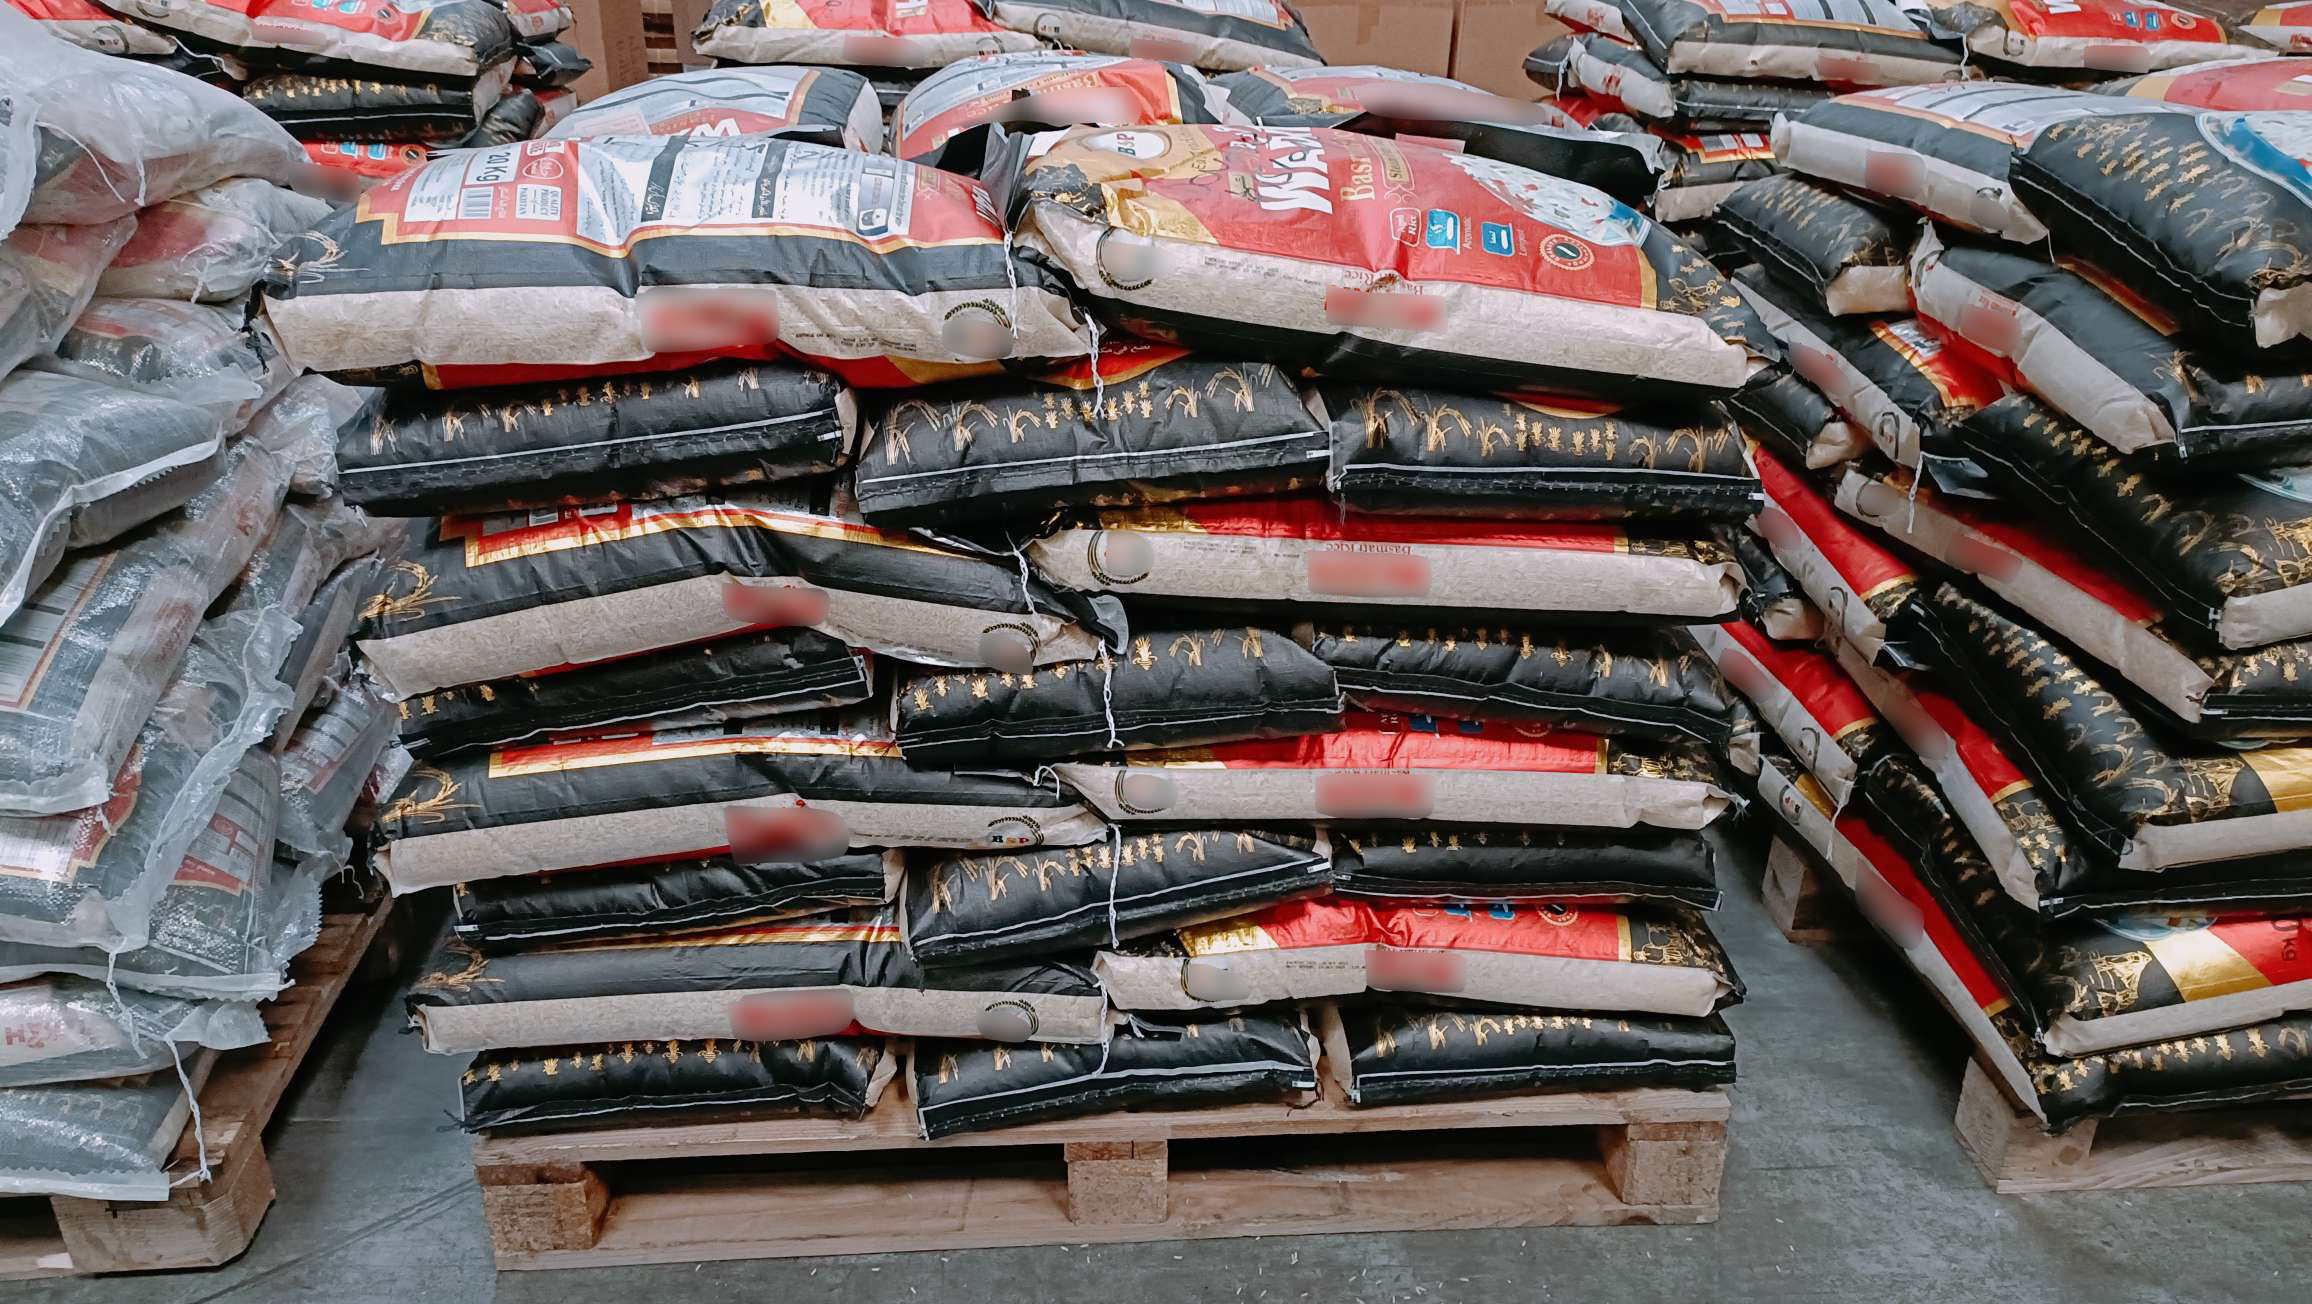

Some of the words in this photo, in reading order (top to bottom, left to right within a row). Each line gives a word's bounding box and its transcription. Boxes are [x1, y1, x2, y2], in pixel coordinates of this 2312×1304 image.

[487, 152, 512, 164] 20
[476, 166, 508, 182] Kg
[519, 187, 529, 215] PAKISTAN
[539, 189, 550, 216] PRODUCT
[550, 190, 560, 216] QUALITY
[1408, 215, 1418, 234] Rice
[1344, 270, 1375, 286] Rice
